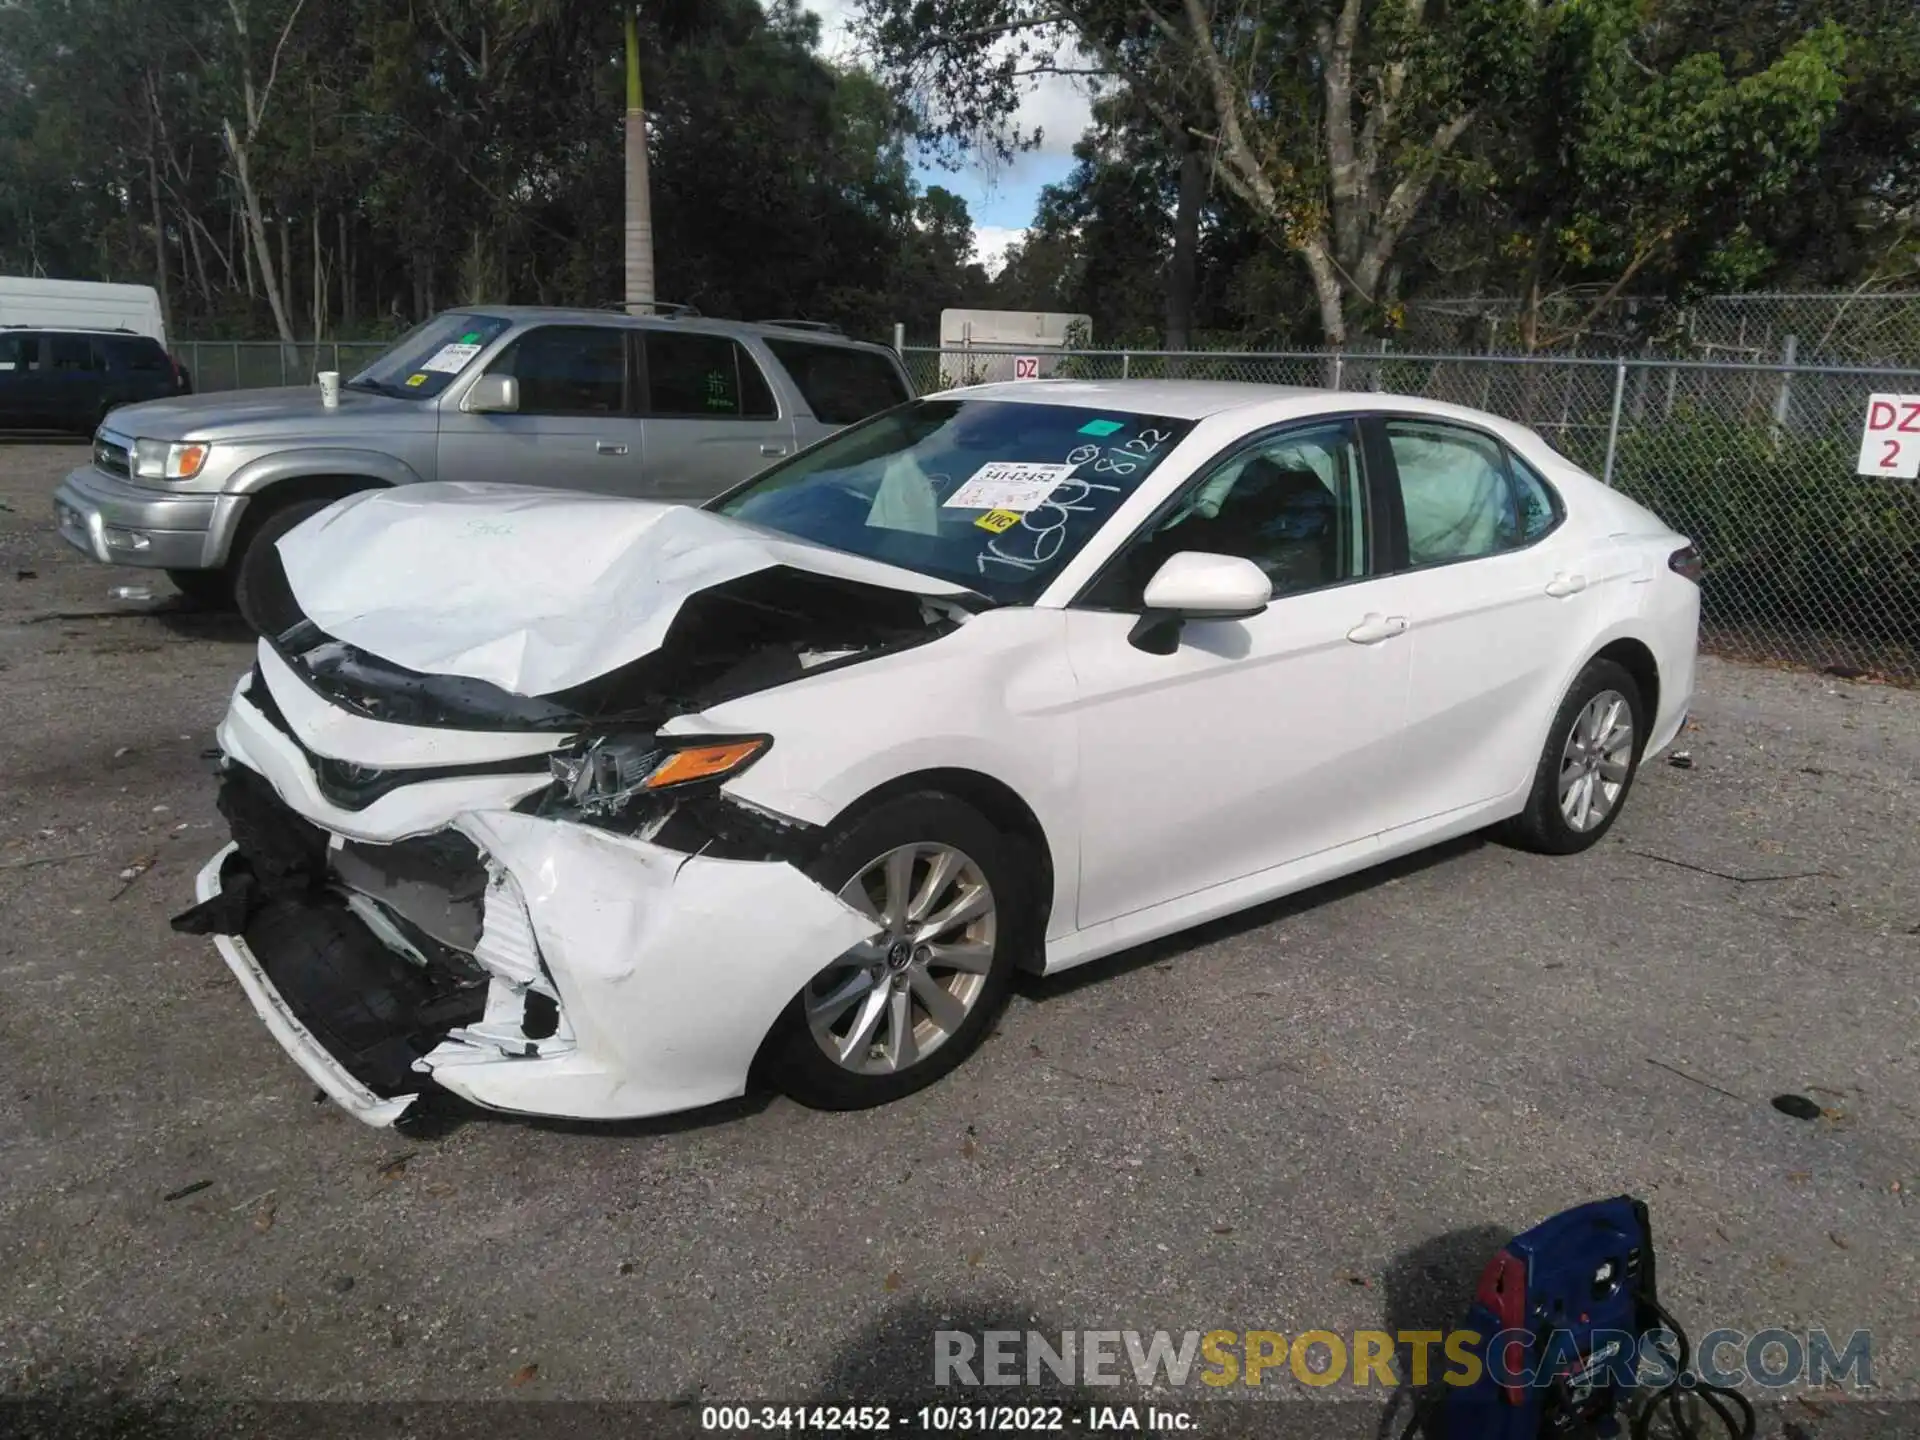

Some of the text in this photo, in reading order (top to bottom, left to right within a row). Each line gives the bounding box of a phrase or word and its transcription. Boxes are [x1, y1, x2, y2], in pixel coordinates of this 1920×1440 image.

[1016, 359, 1037, 378] DZ
[1868, 401, 1920, 432] DZ
[1880, 439, 1901, 468] 2
